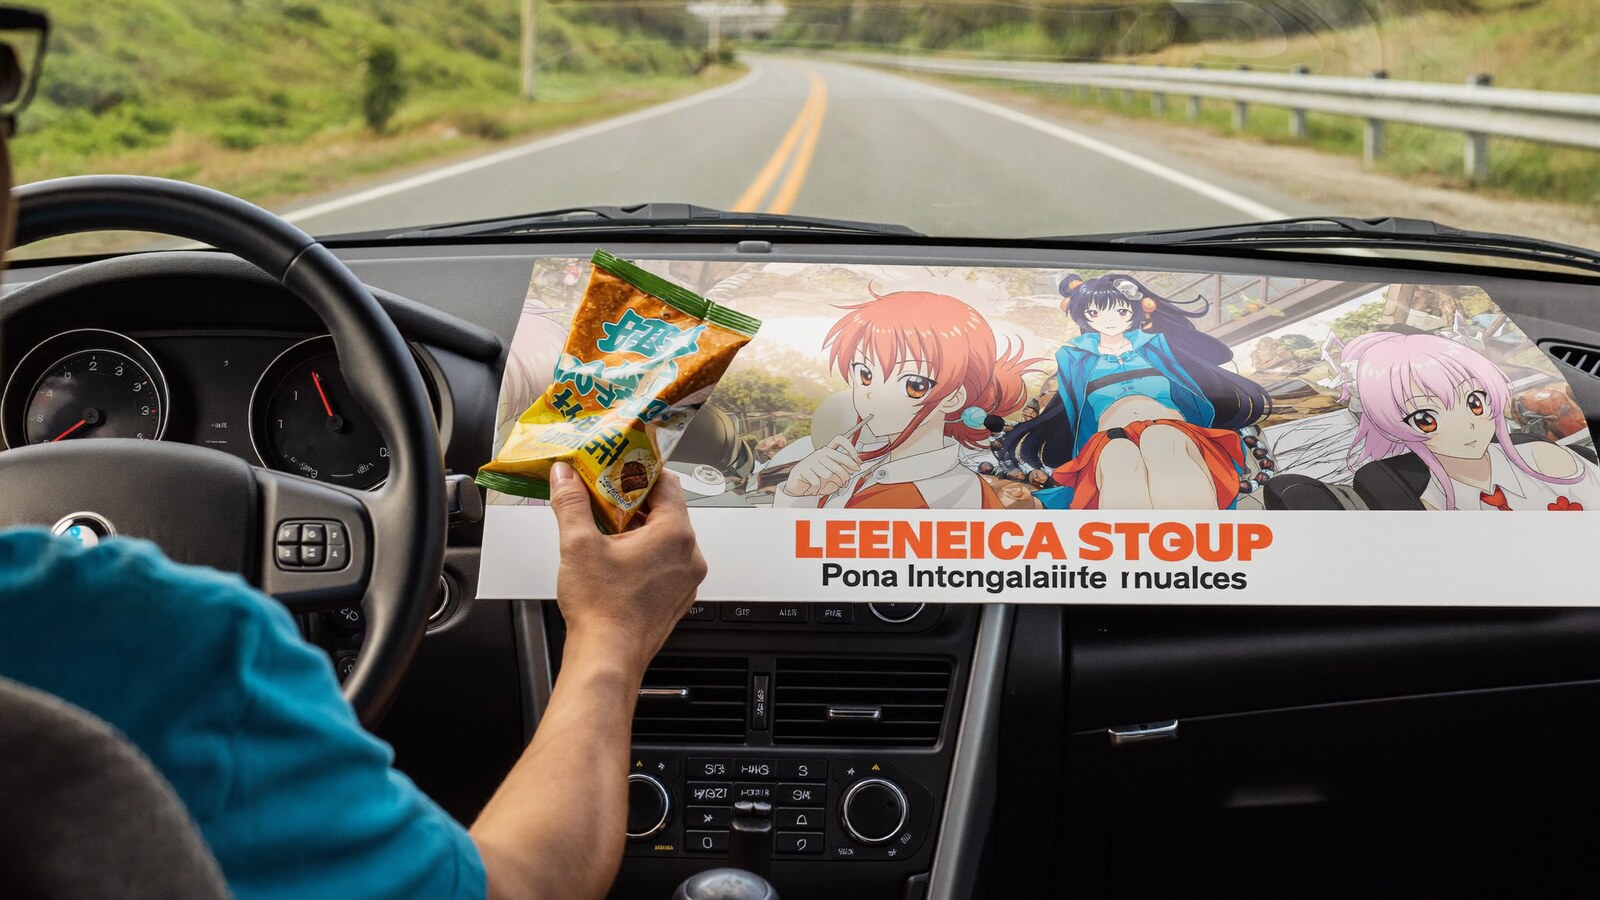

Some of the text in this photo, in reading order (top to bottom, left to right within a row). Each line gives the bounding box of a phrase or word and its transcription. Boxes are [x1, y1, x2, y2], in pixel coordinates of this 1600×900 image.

[89, 361, 98, 371] 2
[795, 519, 1067, 561] LEENEICA
[822, 562, 898, 588] Pona
